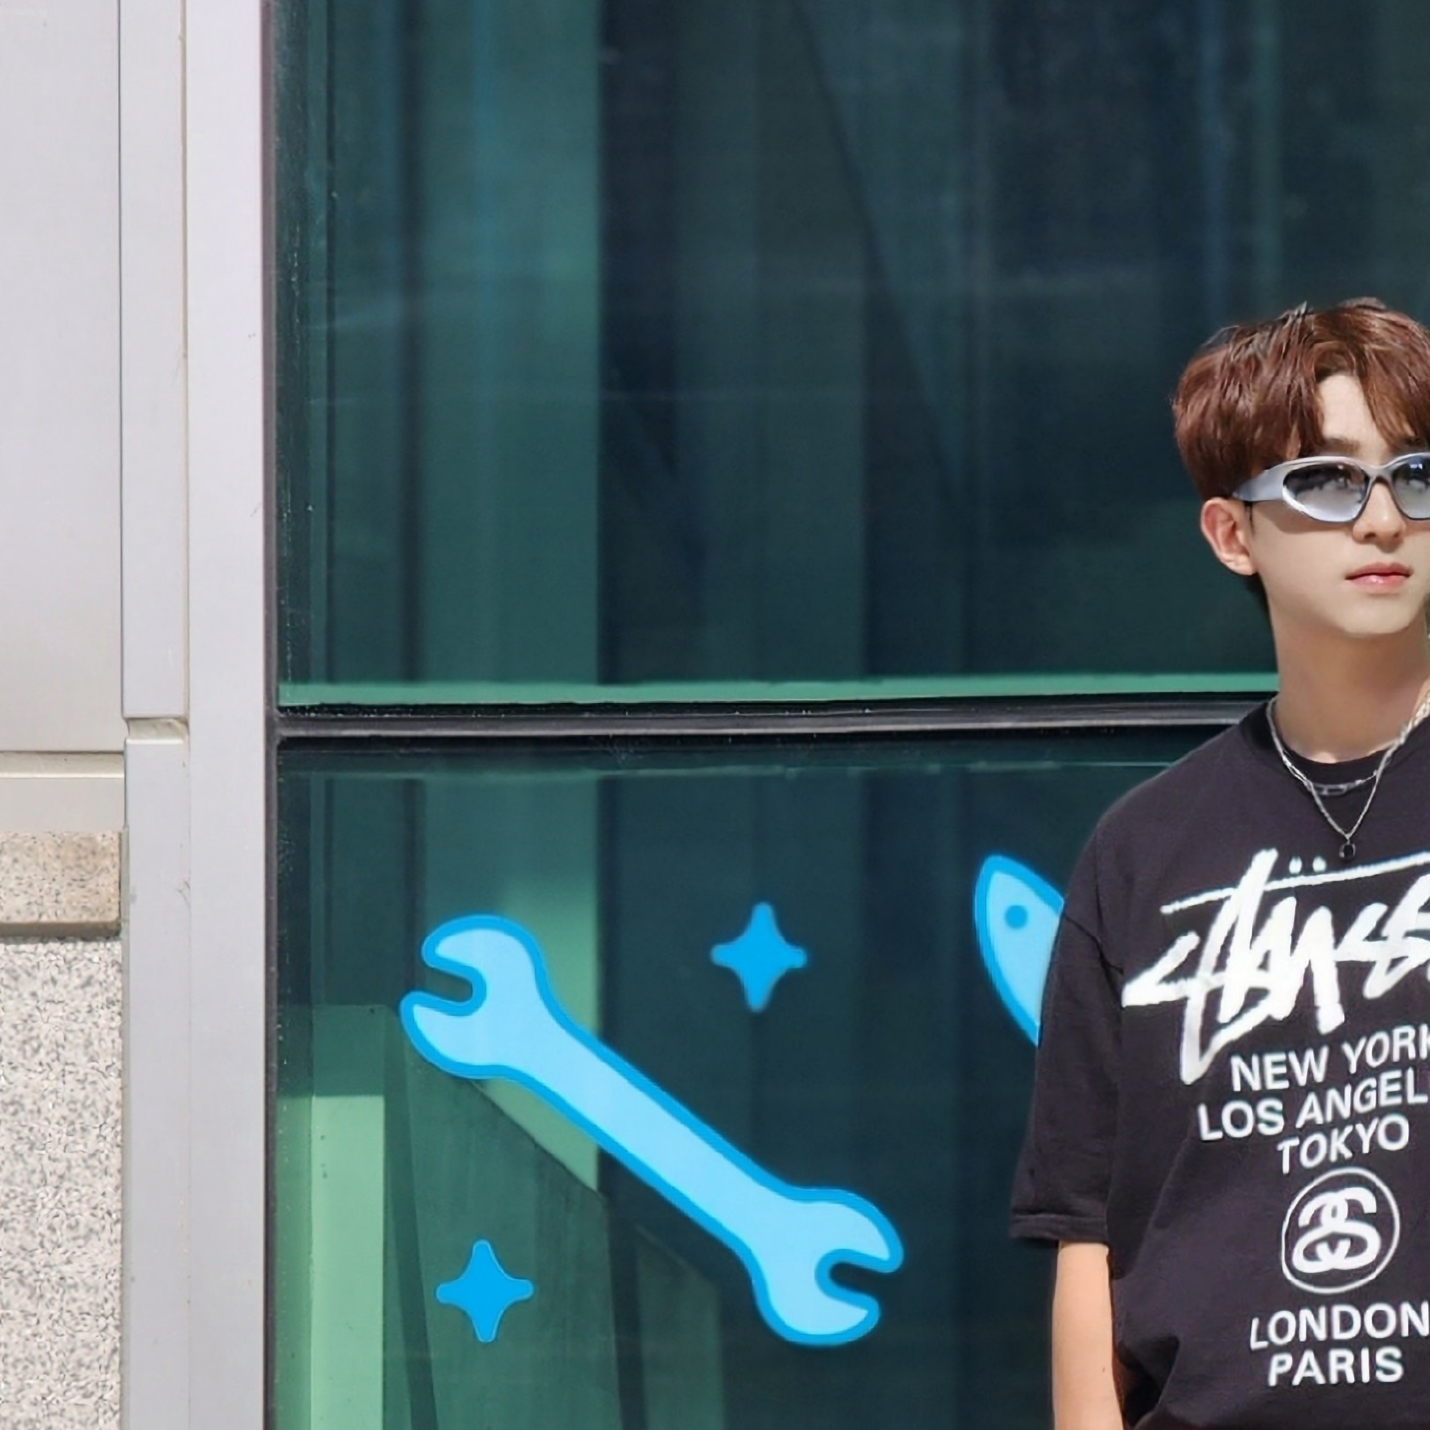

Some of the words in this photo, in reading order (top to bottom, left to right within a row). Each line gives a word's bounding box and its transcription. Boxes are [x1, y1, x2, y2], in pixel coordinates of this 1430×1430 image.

[1230, 1045, 1330, 1092] NEW
[1197, 1098, 1285, 1141] LOS
[1276, 1113, 1410, 1175] TOKYO
[1249, 1300, 1430, 1351] LONDON
[1267, 1346, 1404, 1387] PARIS
